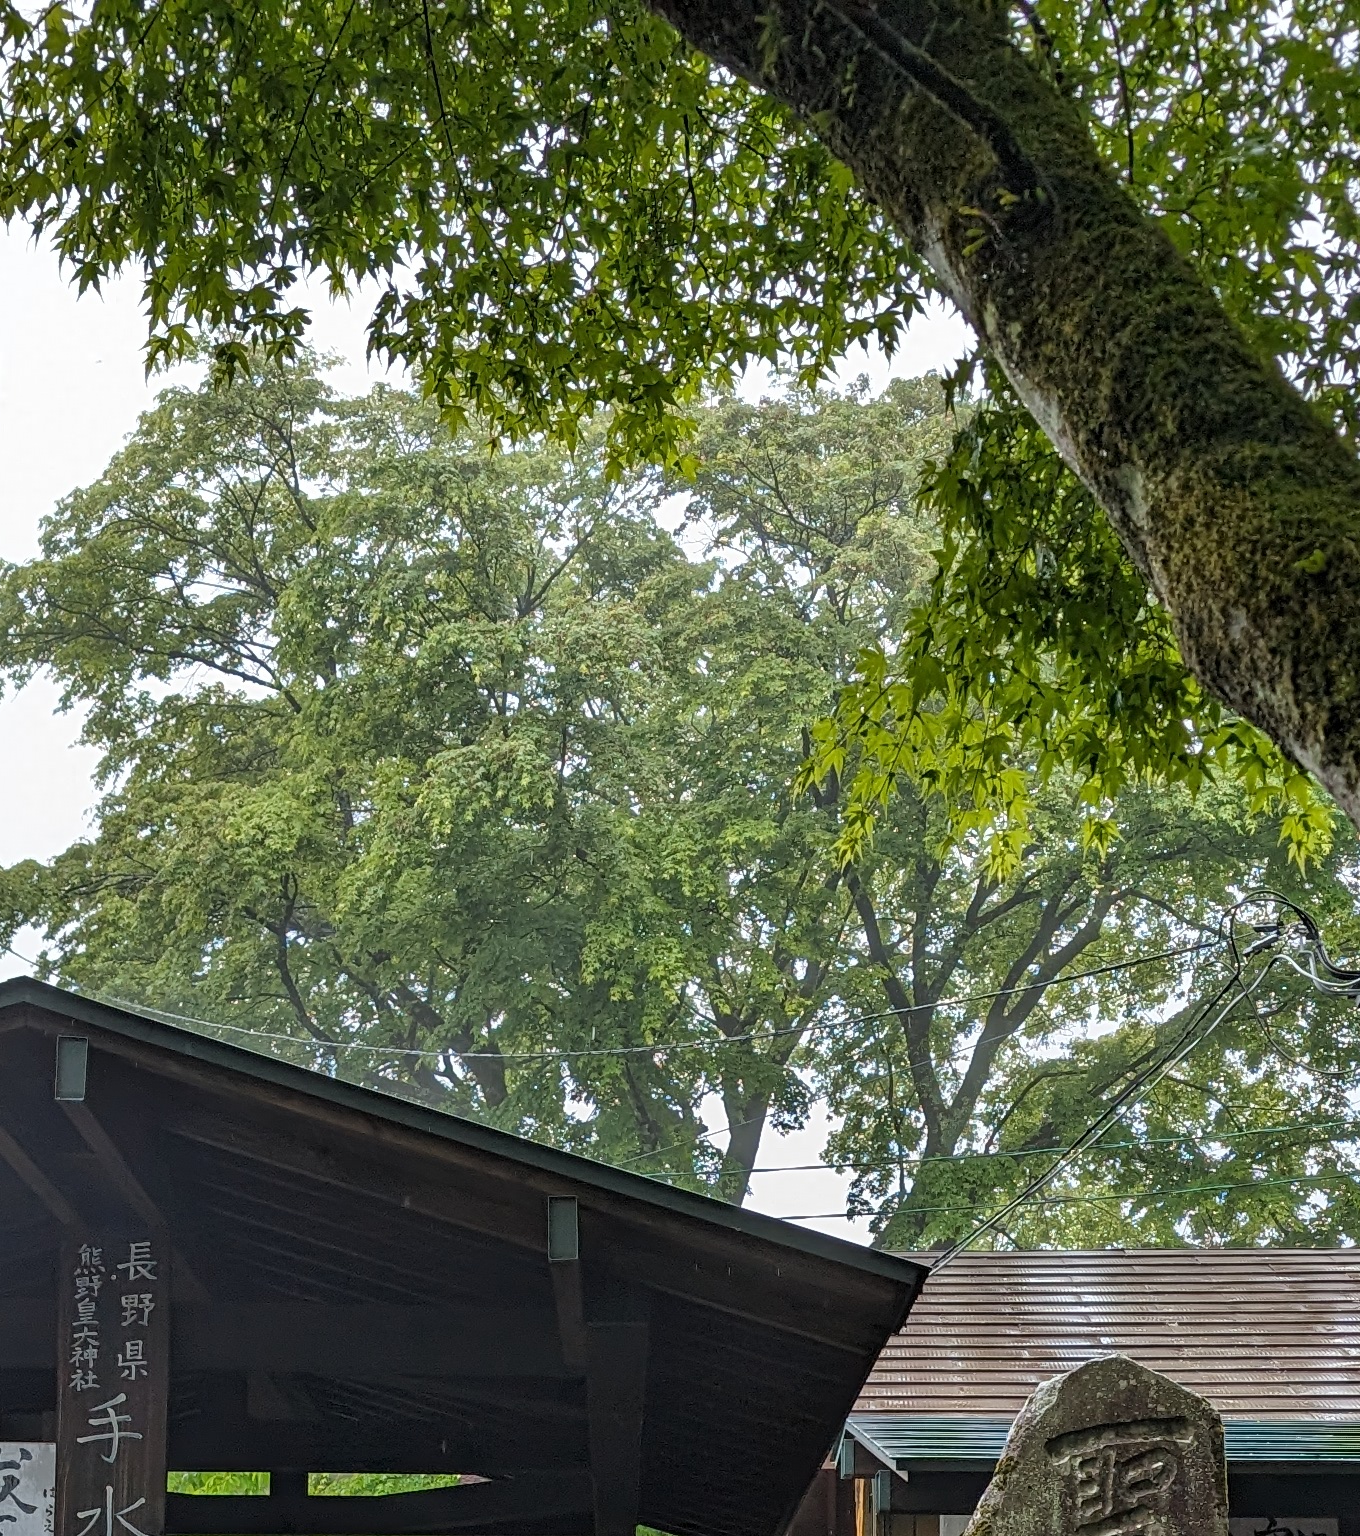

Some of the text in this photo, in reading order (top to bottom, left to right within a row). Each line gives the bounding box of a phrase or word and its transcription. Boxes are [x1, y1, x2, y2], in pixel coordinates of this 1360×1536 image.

[69, 1243, 106, 1392] 熊野皇大神社
[116, 1241, 158, 1382] 長野県
